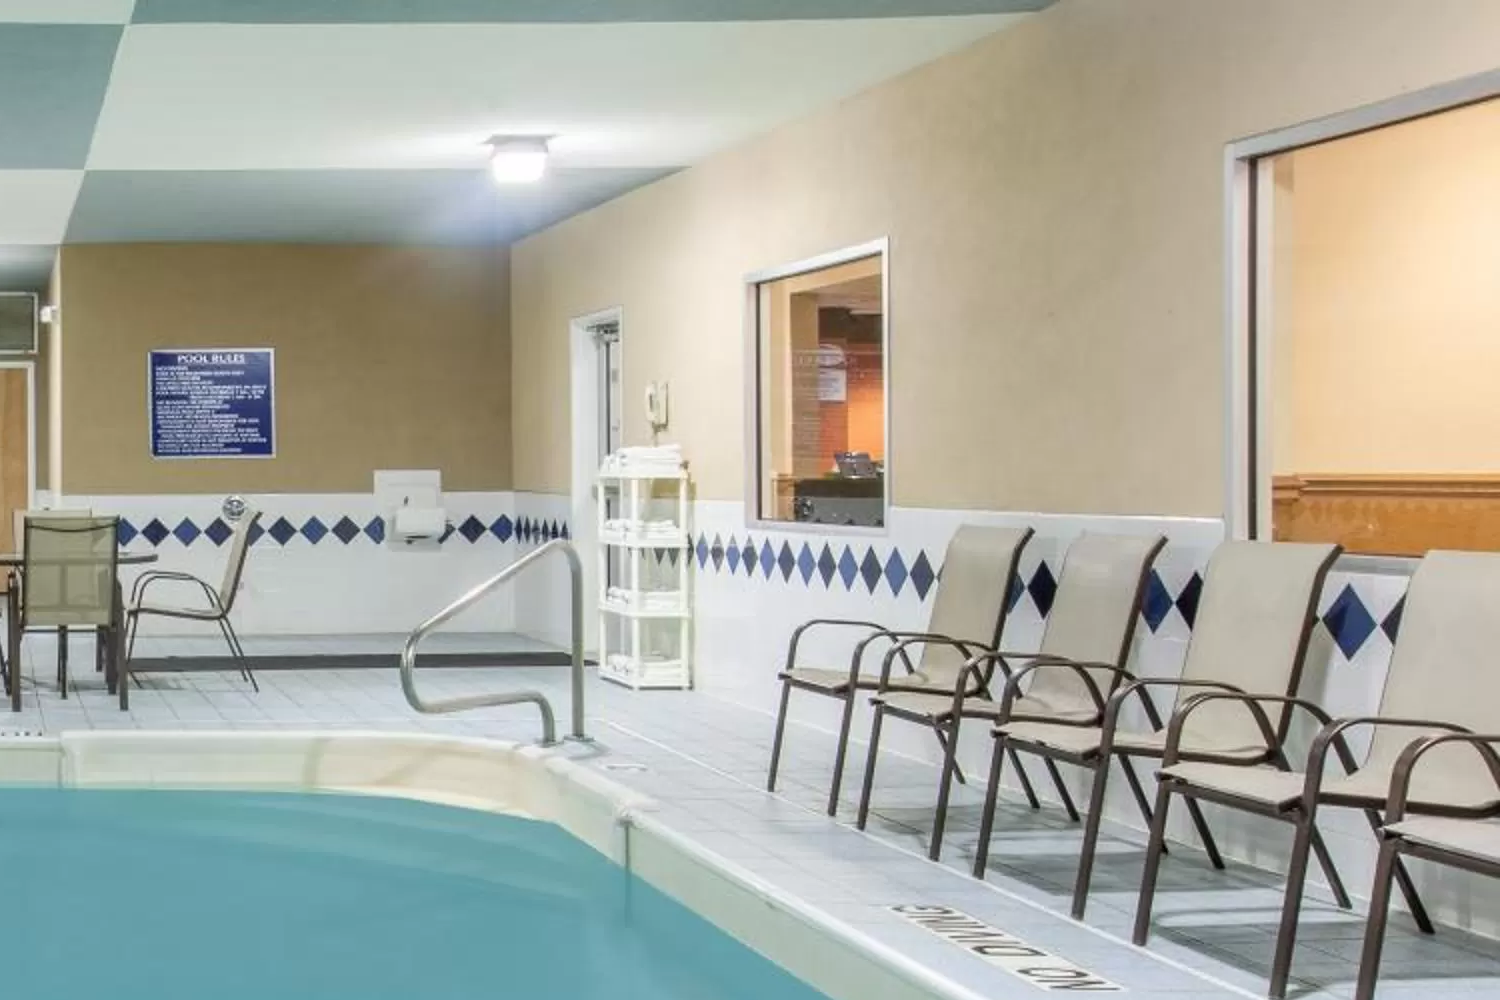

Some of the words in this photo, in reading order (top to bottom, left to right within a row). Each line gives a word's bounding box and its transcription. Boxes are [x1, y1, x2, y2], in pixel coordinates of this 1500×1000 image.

[177, 354, 209, 364] POOL
[212, 353, 245, 364] RULES
[891, 905, 1047, 957] DIVING
[1016, 967, 1121, 991] NO
